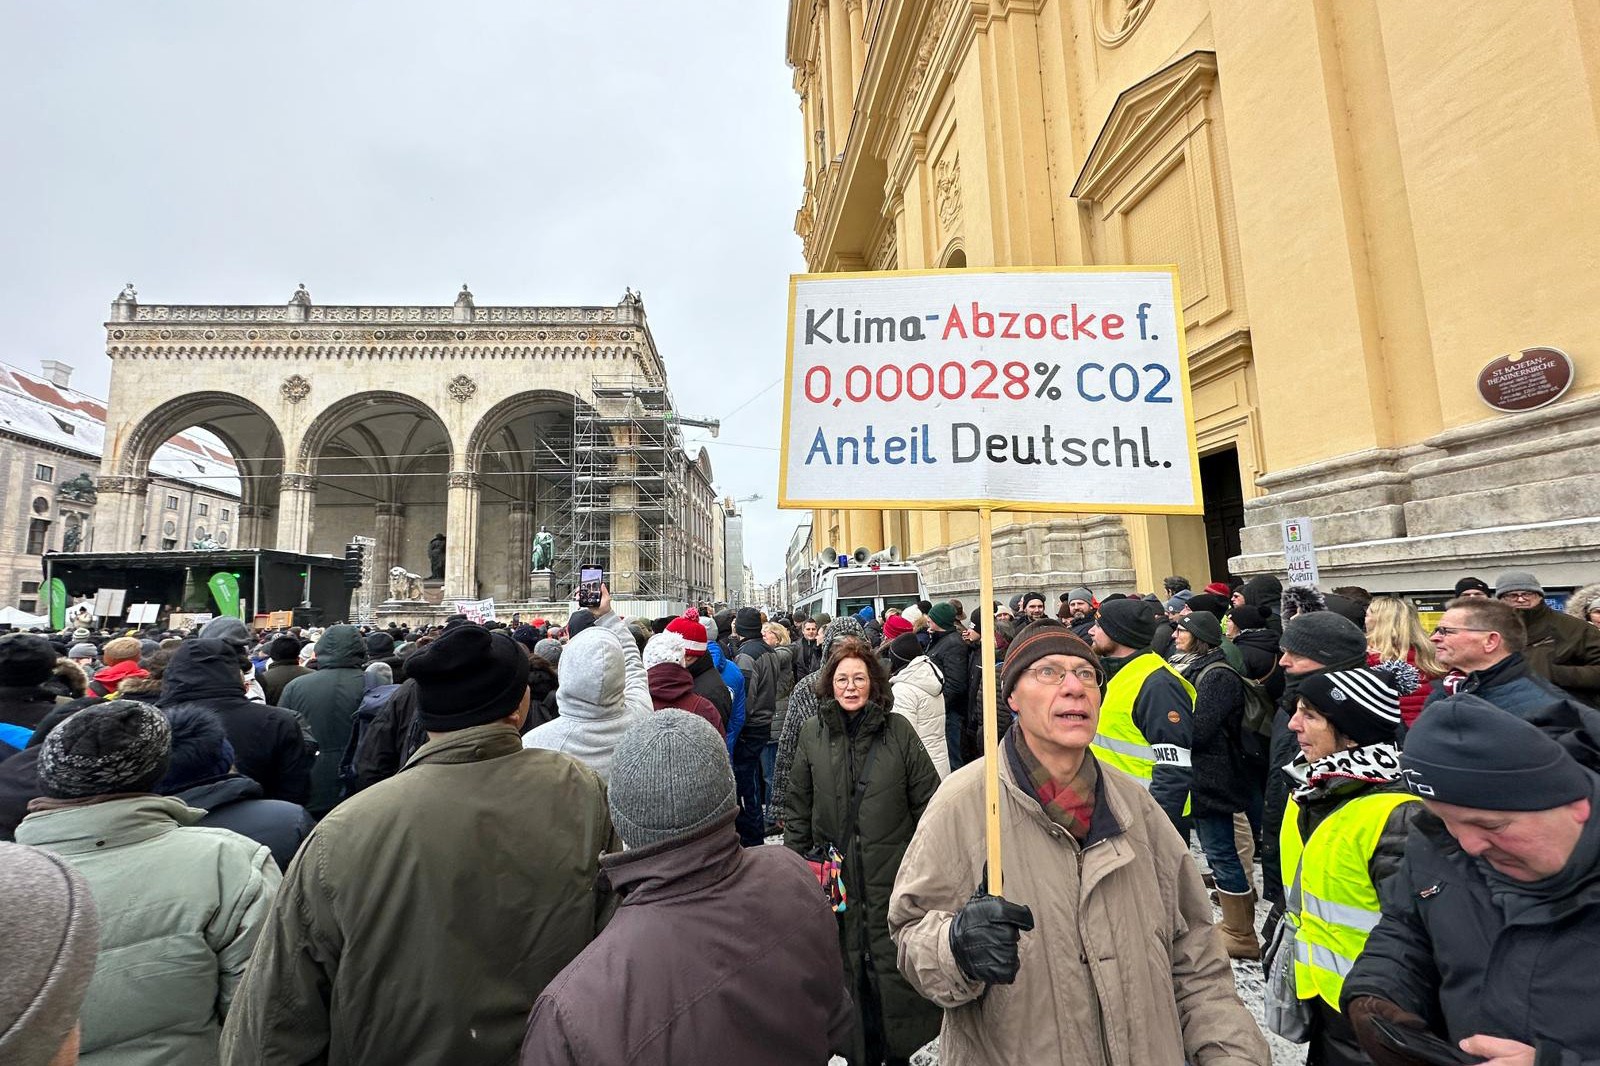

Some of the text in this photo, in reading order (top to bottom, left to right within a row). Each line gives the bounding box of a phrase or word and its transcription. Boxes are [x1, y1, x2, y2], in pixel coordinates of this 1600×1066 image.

[805, 301, 1159, 345] Klima-Abzocke f.
[1487, 360, 1557, 386] THEATINERKIRCHE
[1504, 357, 1546, 374] KAJETAN-
[804, 360, 1173, 408] 0,000028% CO2
[804, 423, 1172, 469] Anteil Deutschl.
[1286, 543, 1310, 554] MACHT
[1288, 560, 1311, 571] ALLE
[1290, 554, 1306, 562] UNS
[1289, 572, 1313, 583] KAPUTT
